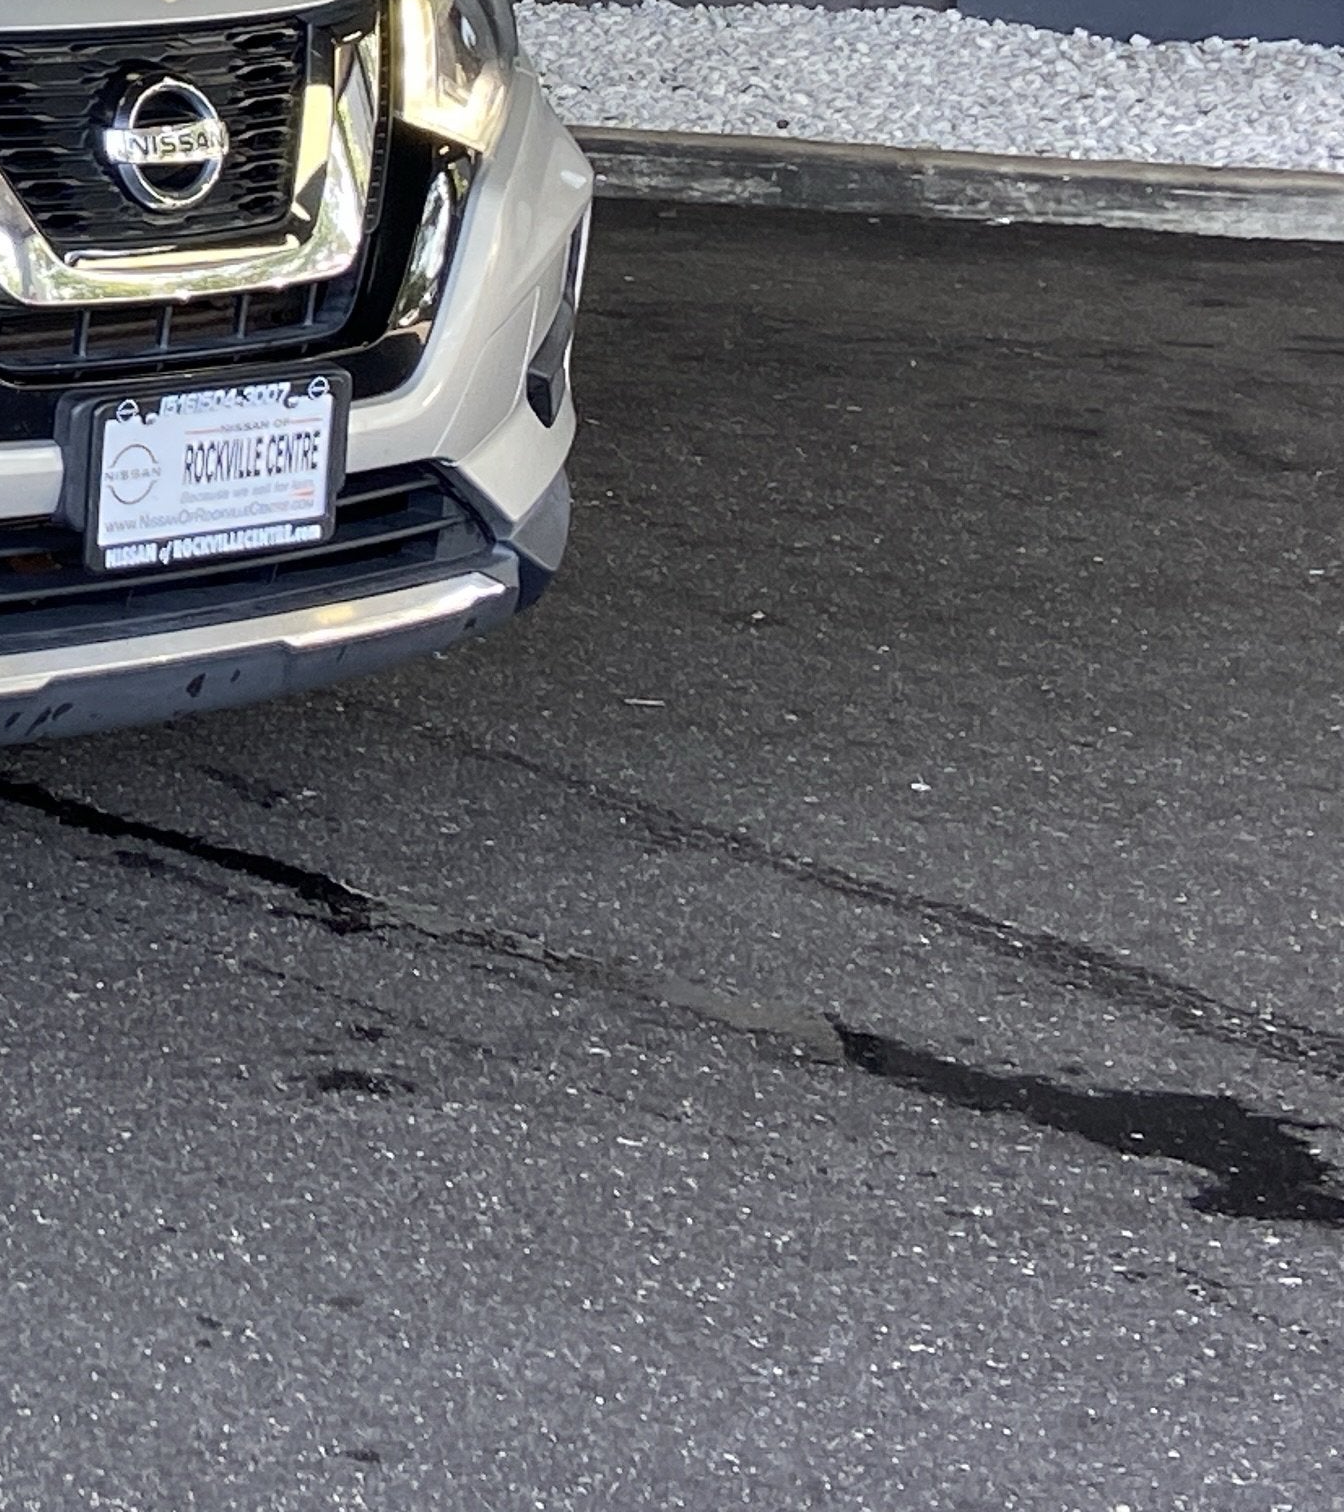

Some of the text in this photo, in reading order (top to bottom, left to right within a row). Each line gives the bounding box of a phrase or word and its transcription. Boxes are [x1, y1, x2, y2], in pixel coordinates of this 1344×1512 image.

[130, 128, 227, 157] NISSAN
[183, 430, 321, 485] ROCKVILLE CENTRE
[105, 467, 161, 482] NISSAN
[105, 542, 158, 569] NISSAN
